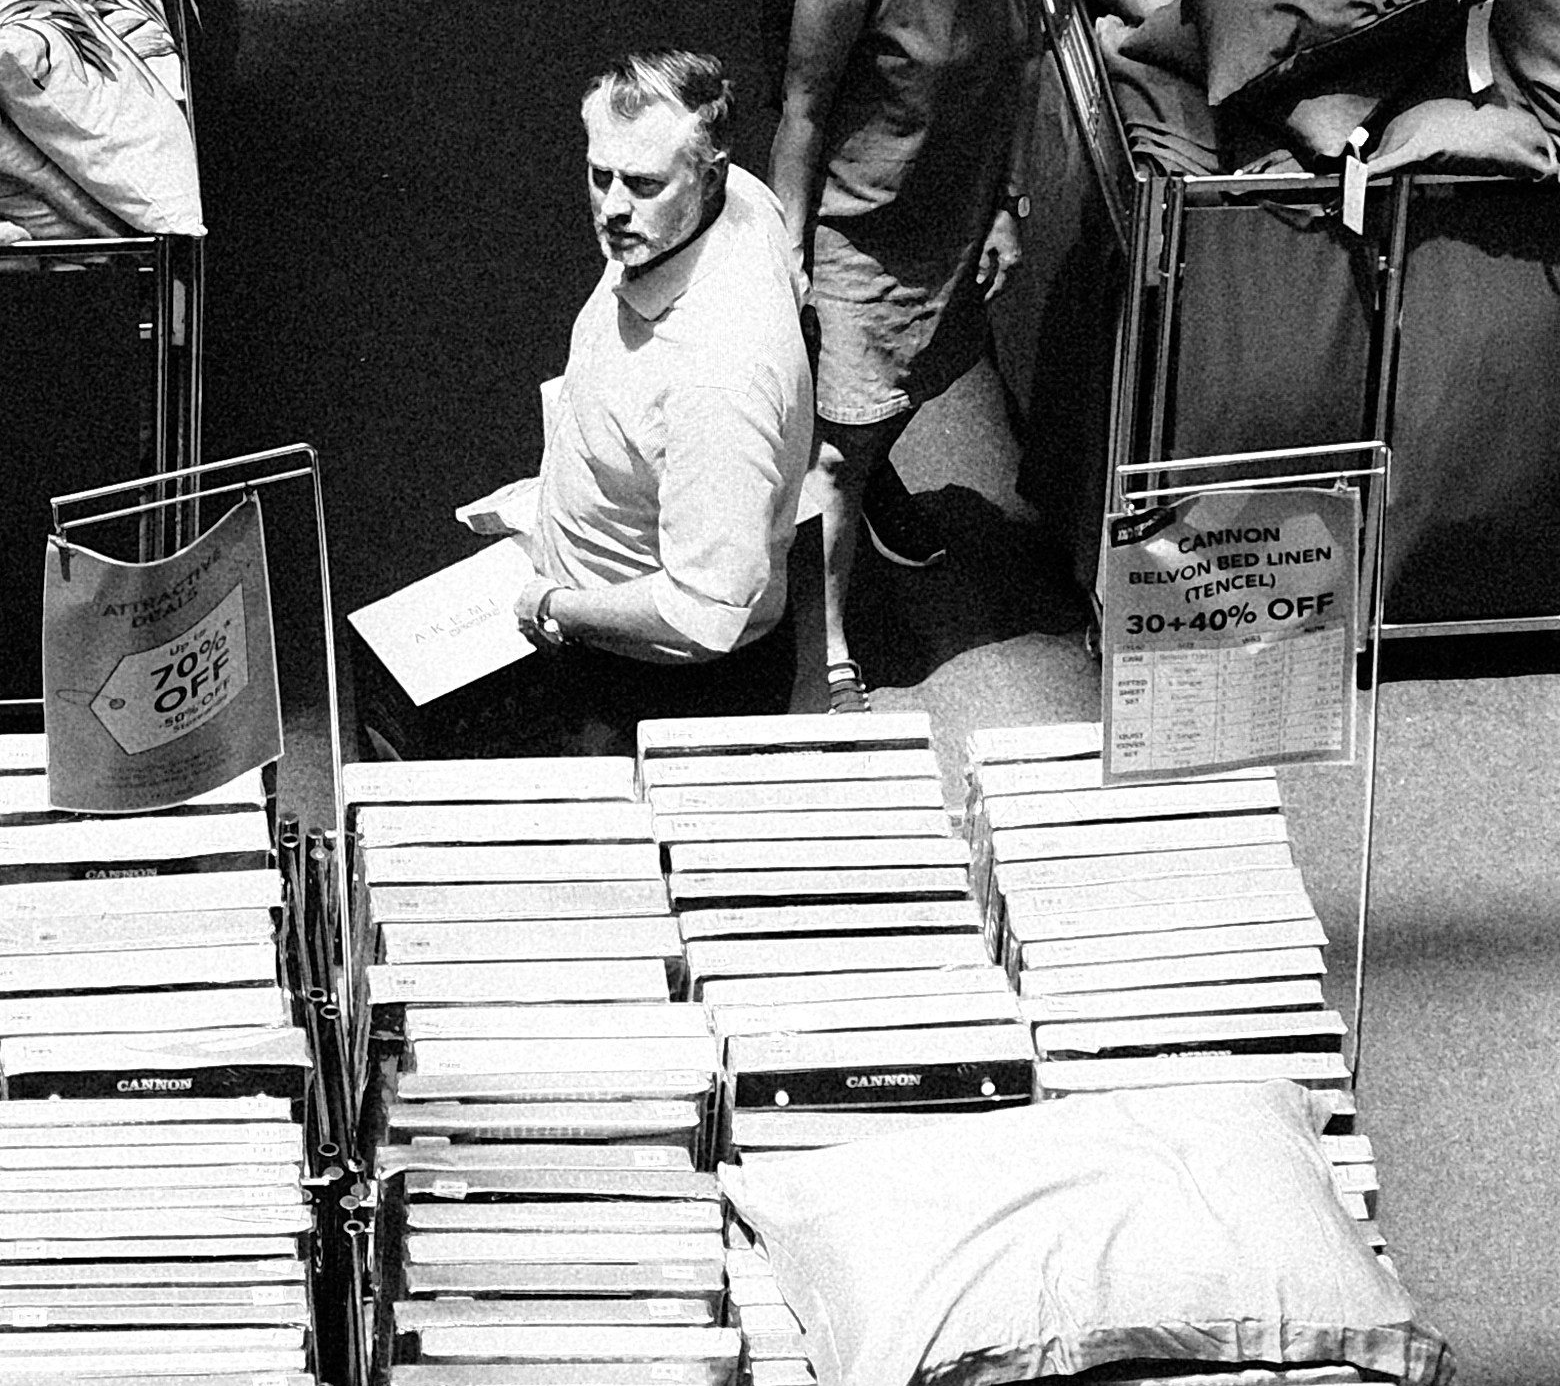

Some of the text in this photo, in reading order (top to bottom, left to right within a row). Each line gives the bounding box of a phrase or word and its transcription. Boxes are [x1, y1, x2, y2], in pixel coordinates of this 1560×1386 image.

[1178, 527, 1281, 554] CANNON
[102, 547, 222, 616] ATTRACTIVE
[1129, 546, 1332, 585] BELVON BED LINEN
[1185, 573, 1276, 603] (TENCEL)
[131, 588, 198, 628] DEALS
[1125, 592, 1334, 635] 30+40% OFF
[151, 631, 227, 690] 70%
[154, 648, 230, 714] OFF
[202, 677, 231, 707] OFF
[85, 868, 158, 880] CANNON
[117, 1078, 193, 1092] CANNON
[846, 1094, 922, 1108] CANNON
